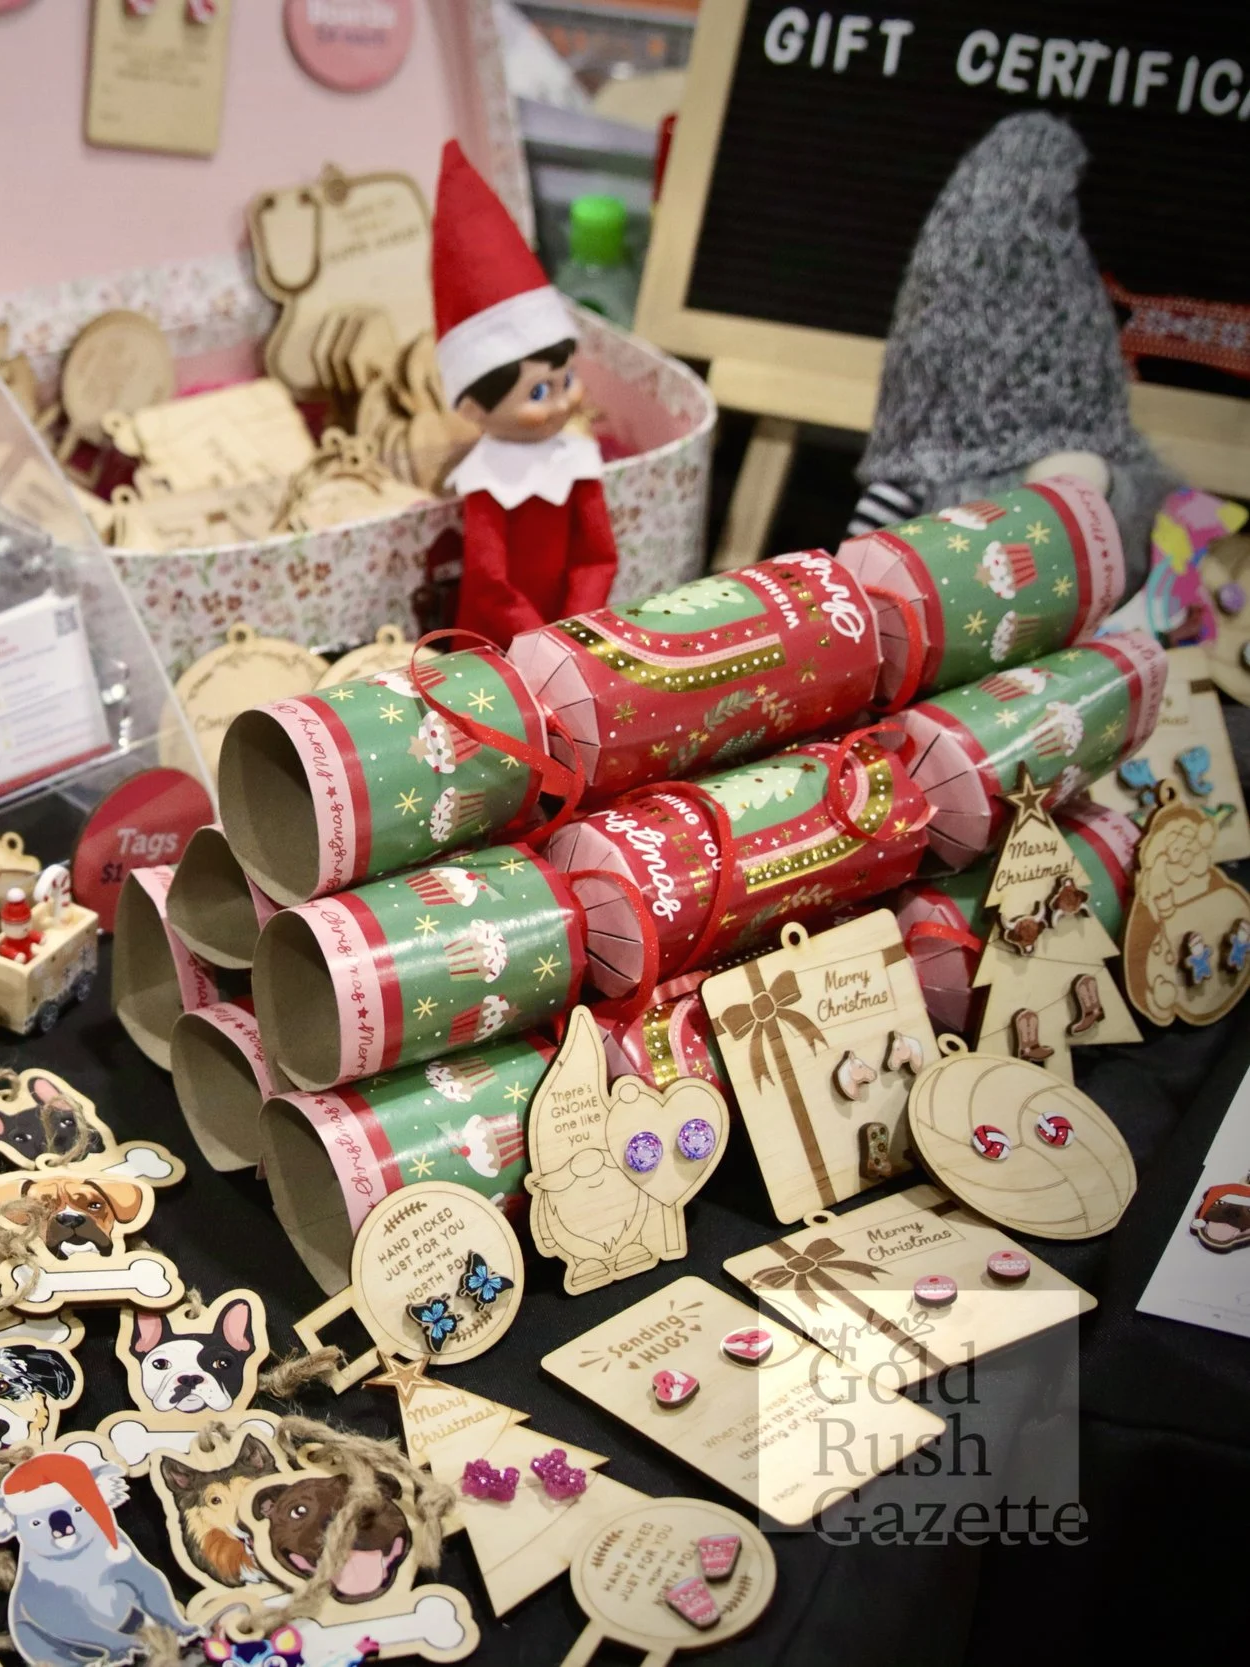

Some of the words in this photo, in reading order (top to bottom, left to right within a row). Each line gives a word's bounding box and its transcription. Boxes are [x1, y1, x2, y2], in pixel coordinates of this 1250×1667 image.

[764, 7, 914, 76] GIFT
[740, 568, 800, 629] WISHING
[117, 828, 179, 861] Tags
[1008, 841, 1058, 861] Merry
[588, 809, 681, 922] ristmas
[995, 857, 1076, 891] Christmas!
[321, 905, 368, 1004] Chrismas
[824, 970, 871, 993] Merry
[817, 990, 888, 1022] Christmas
[551, 1083, 593, 1104] There's
[551, 1096, 598, 1119] GNOME
[554, 1120, 577, 1133] one
[580, 1113, 601, 1126] like
[378, 1237, 410, 1265] HAND
[412, 1207, 453, 1240] PICKED
[867, 1222, 924, 1244] Merry
[867, 1230, 952, 1262] Christmas
[385, 1256, 412, 1282] JUST
[416, 1239, 440, 1260] FOR
[441, 1220, 465, 1240] YOU
[413, 1261, 435, 1278] FROM
[437, 1247, 453, 1261] THE
[406, 1273, 444, 1304] NORTH
[447, 1254, 470, 1276] POL
[607, 1314, 686, 1359] Sending
[637, 1329, 690, 1364] HUGS
[406, 1396, 468, 1424] Merry
[741, 1422, 772, 1443] know
[774, 1406, 799, 1425] that
[702, 1427, 741, 1450] When
[738, 1431, 789, 1461] thinking
[788, 1418, 803, 1432] of
[604, 1562, 628, 1591] HAND
[624, 1522, 654, 1558] PICKED
[619, 1573, 641, 1602] JUST
[637, 1550, 656, 1570] FOR
[654, 1525, 673, 1545] YOU
